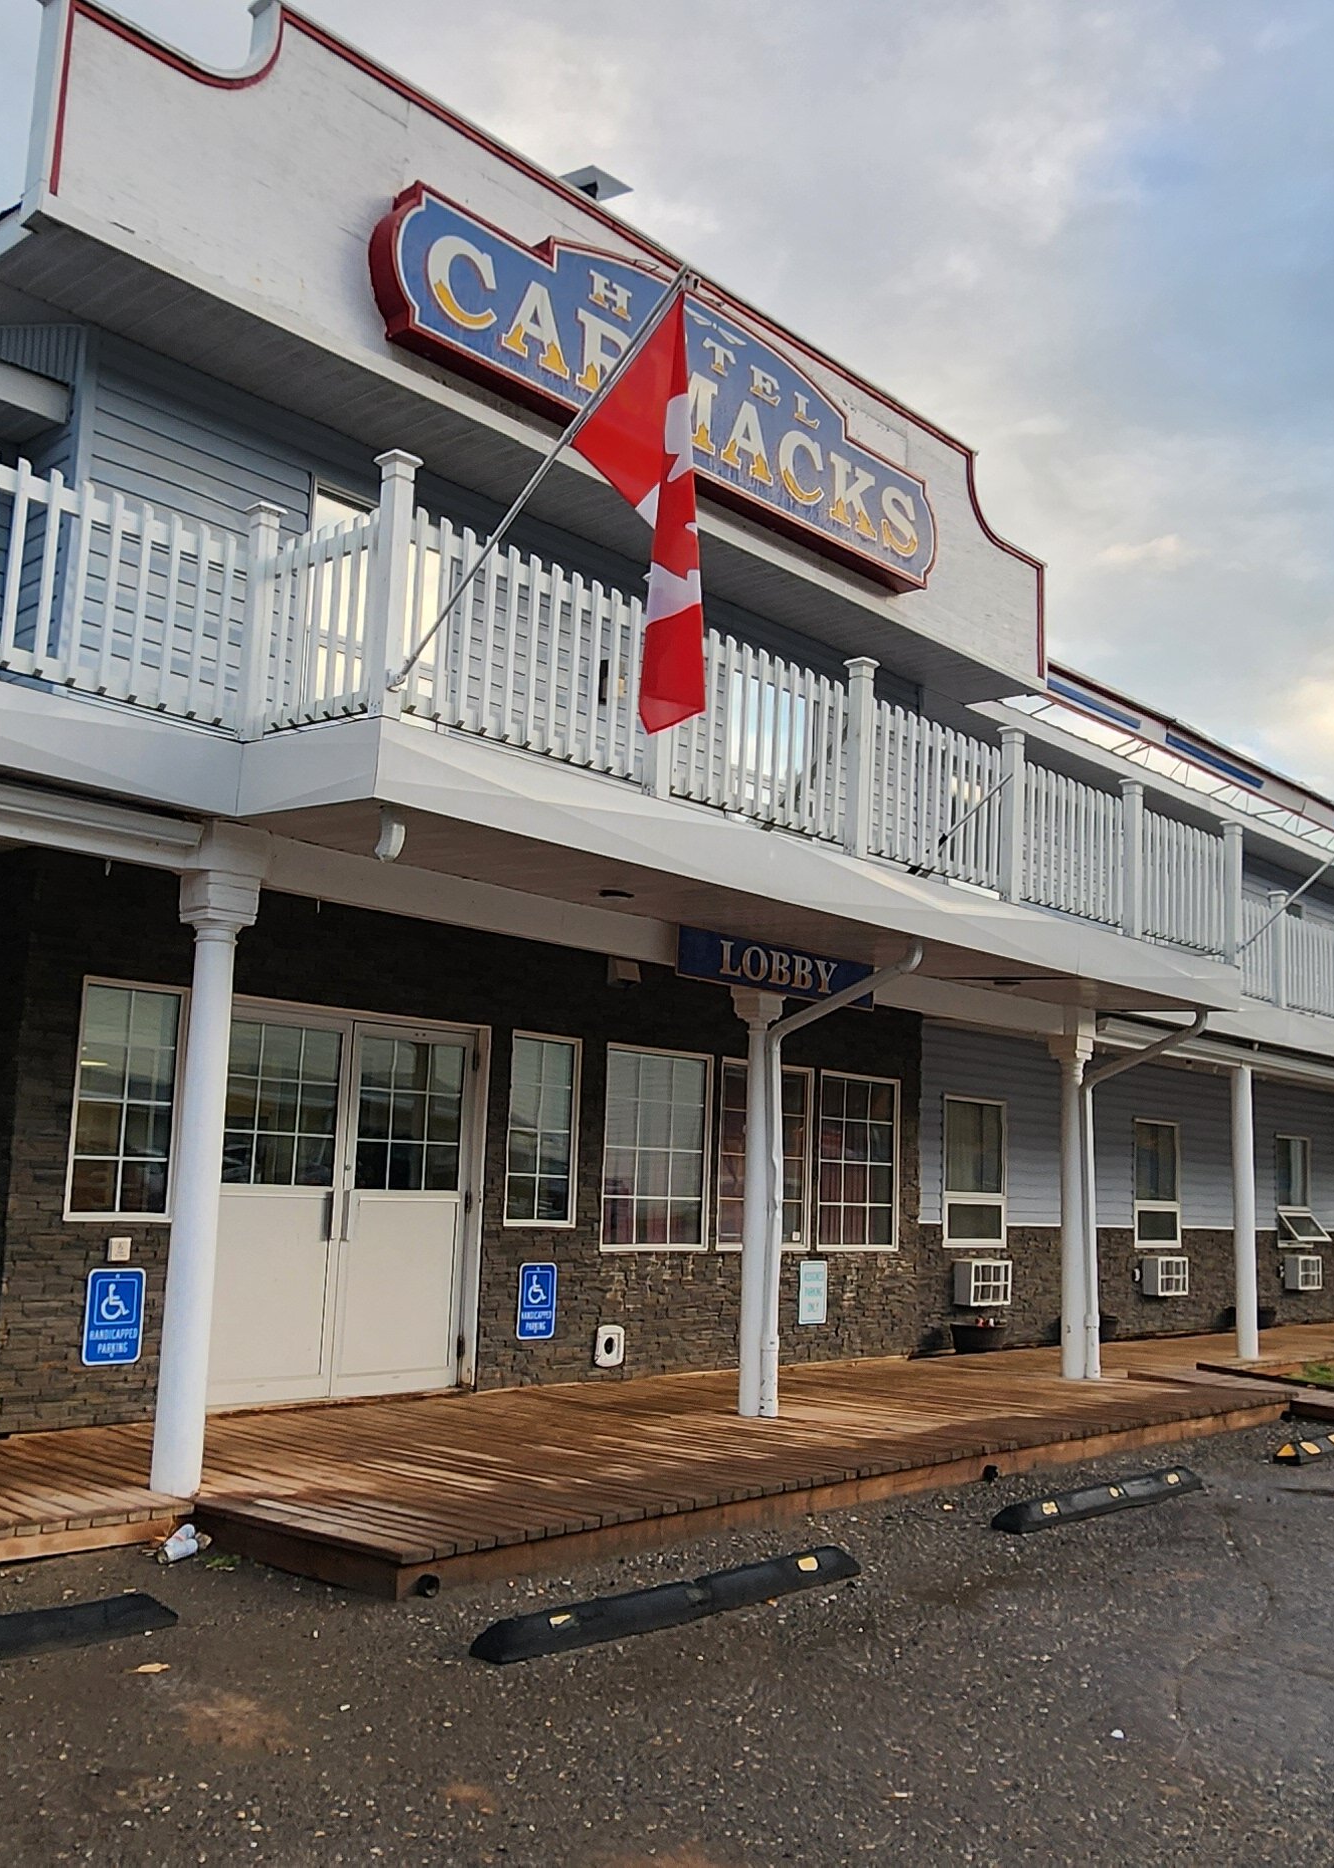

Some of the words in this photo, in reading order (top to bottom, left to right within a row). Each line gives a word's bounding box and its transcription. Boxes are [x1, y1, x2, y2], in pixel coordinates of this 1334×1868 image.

[588, 269, 821, 430] HTEL
[720, 939, 837, 994] LOBBY
[89, 1327, 139, 1340] HANDICAPPED
[97, 1342, 128, 1354] PARKING
